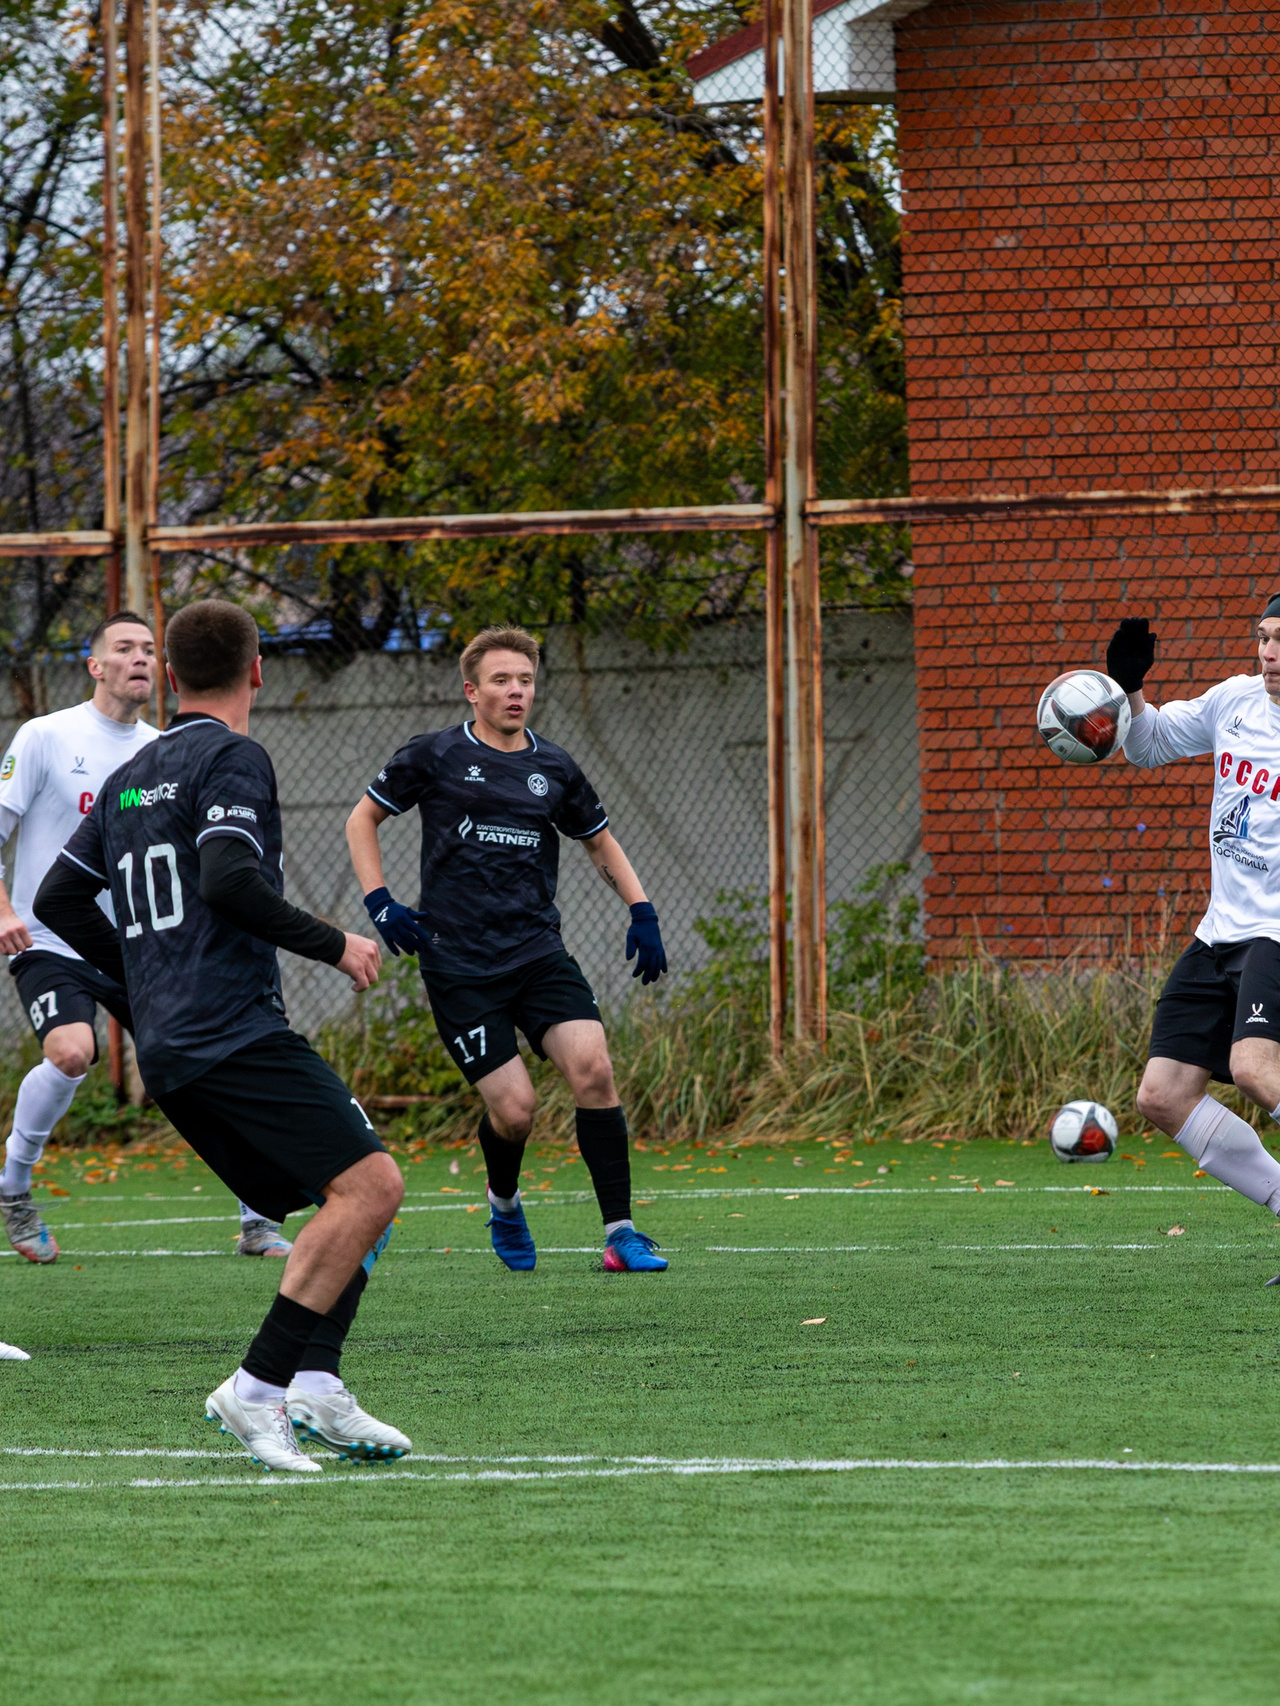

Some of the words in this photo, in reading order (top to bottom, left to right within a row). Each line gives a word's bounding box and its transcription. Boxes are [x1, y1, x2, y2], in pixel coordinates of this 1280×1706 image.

[476, 831, 541, 848] TATNEFT
[117, 842, 184, 939] 10
[29, 990, 59, 1031] 87
[453, 1024, 487, 1064] 17
